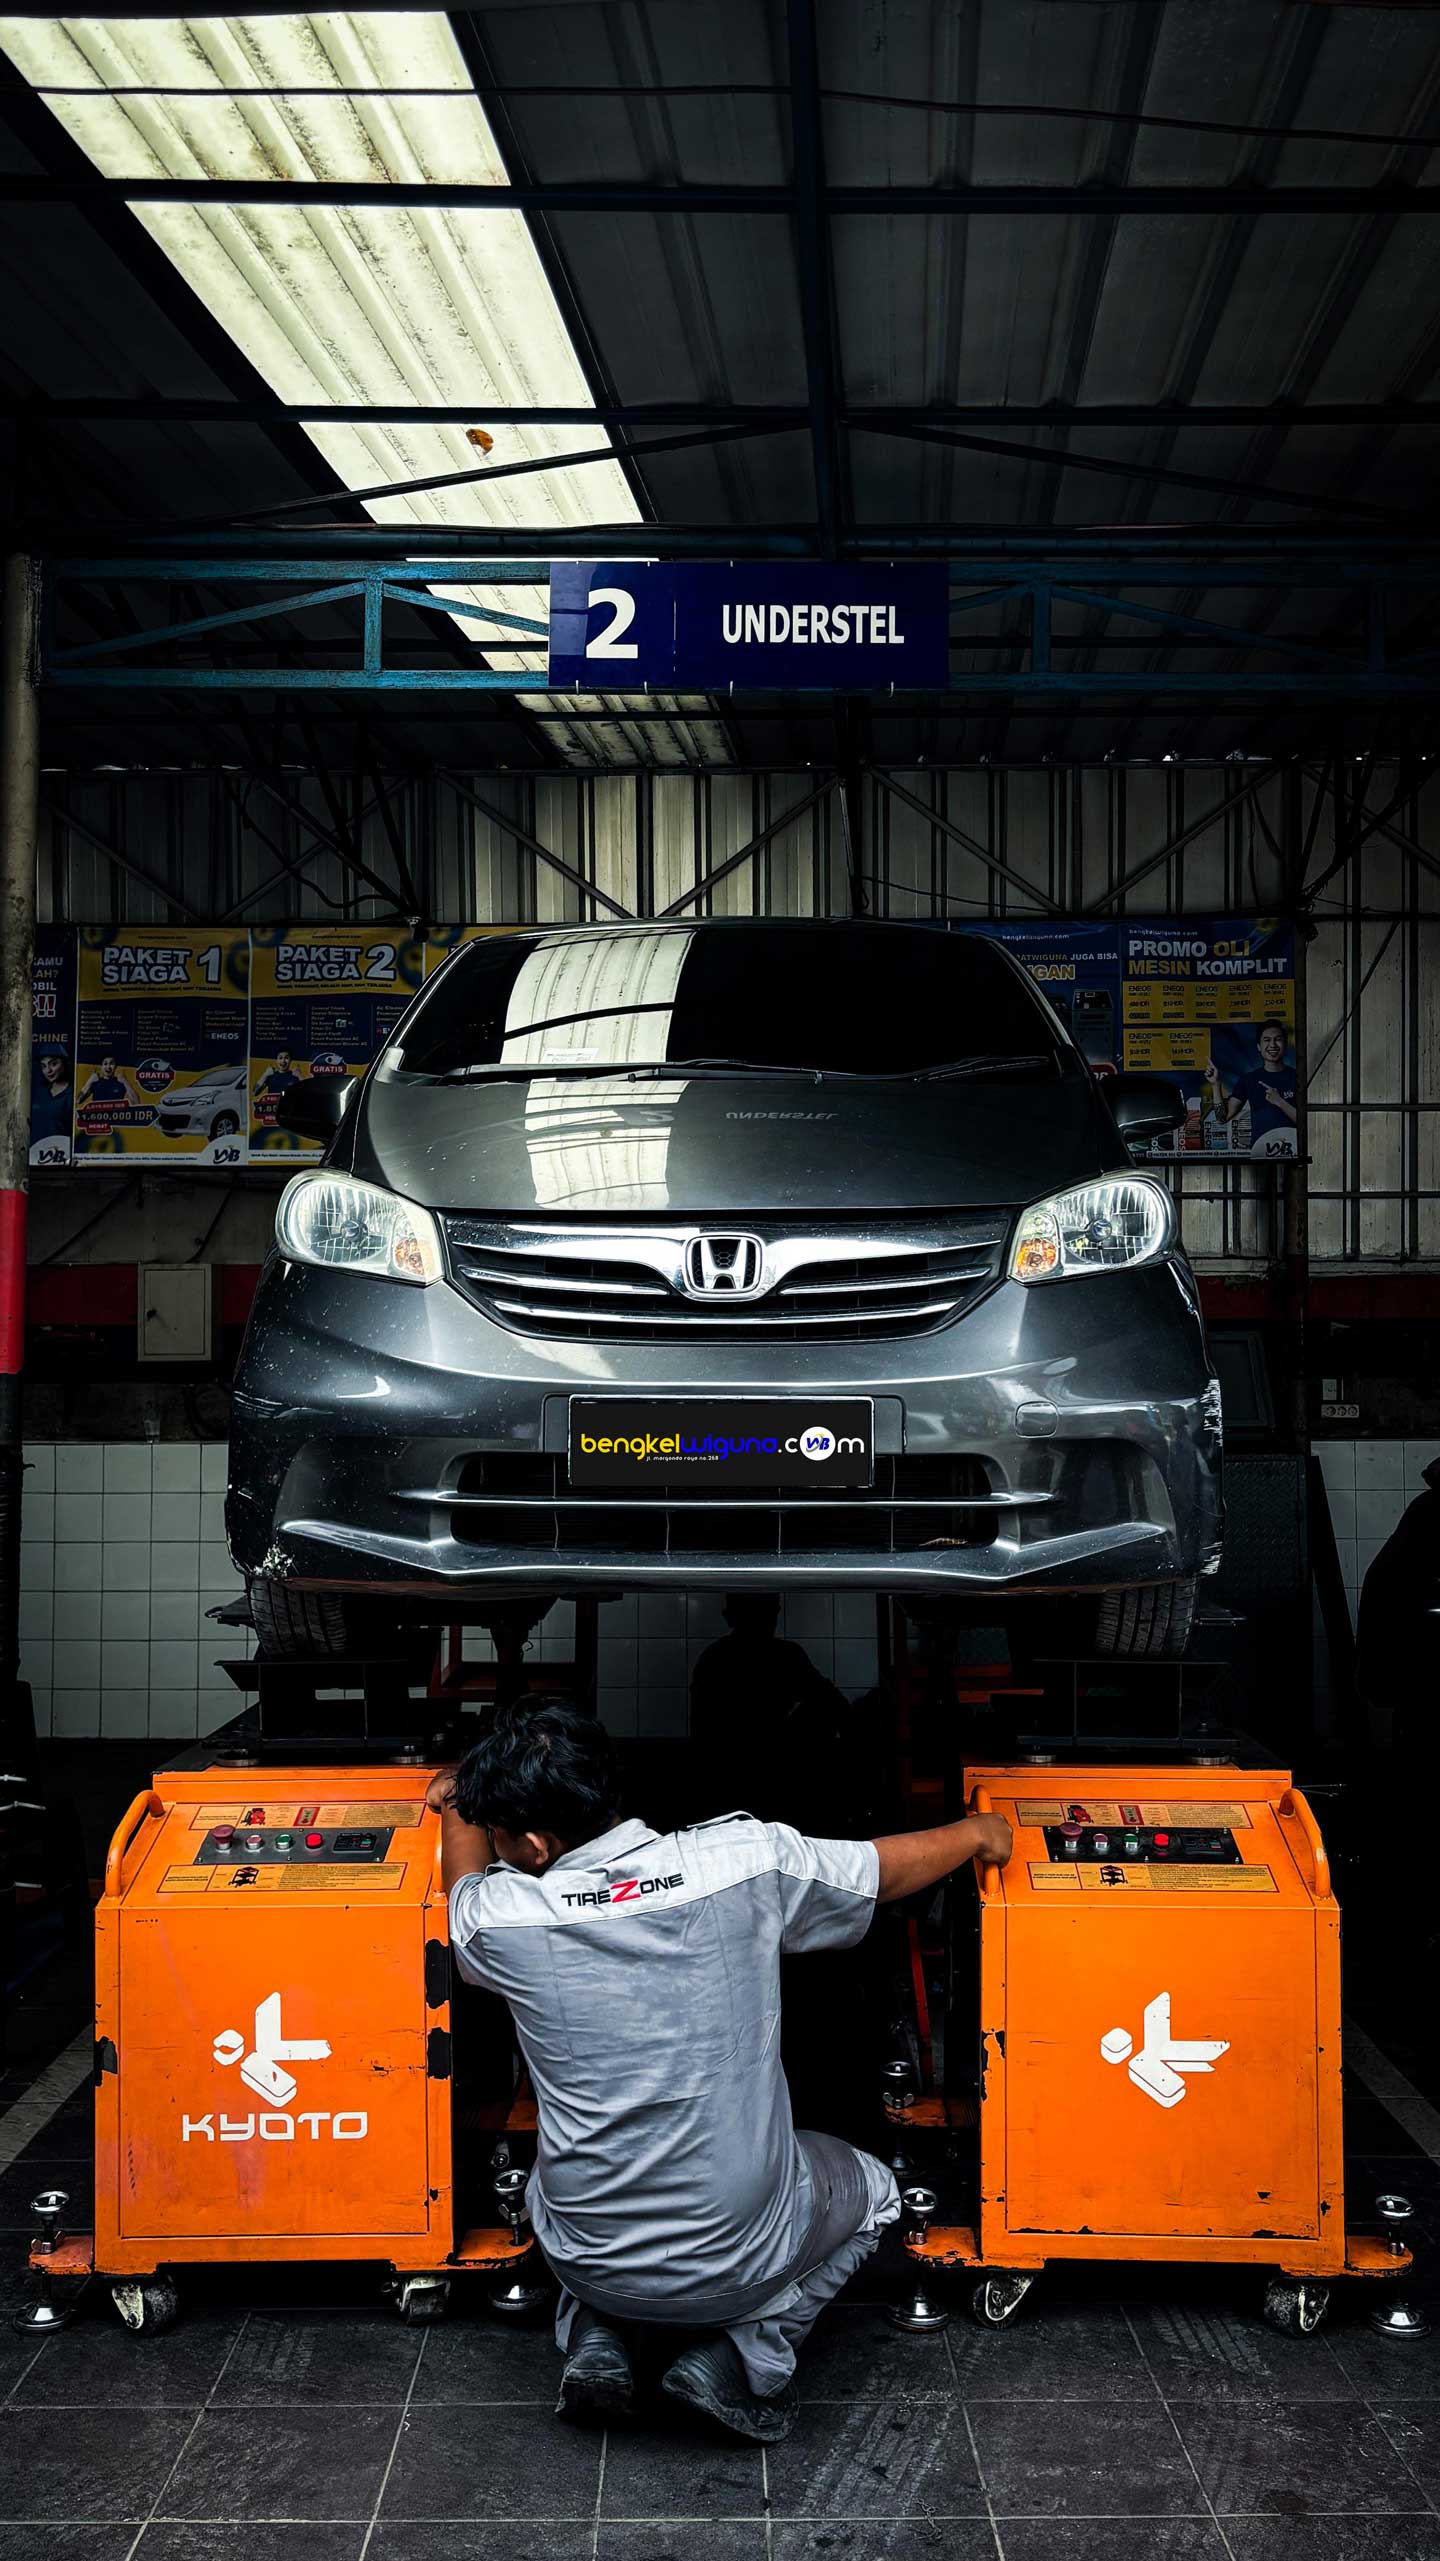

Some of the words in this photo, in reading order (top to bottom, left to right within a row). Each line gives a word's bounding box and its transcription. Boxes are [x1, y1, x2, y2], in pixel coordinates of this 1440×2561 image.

[586, 587, 639, 660] 2
[722, 604, 905, 645] UNDERSTEL
[103, 946, 192, 965] PAKET
[278, 945, 362, 962] PAKET
[1070, 953, 1095, 961] JUGA
[1097, 952, 1119, 960] BISA
[1128, 940, 1207, 958] PROMO
[1213, 940, 1250, 958] OLI
[198, 945, 222, 983] 1
[366, 944, 396, 980] 2
[1128, 959, 1191, 976] MESIN
[1196, 957, 1288, 976] KOMPLIT
[103, 965, 190, 984] SIAGA
[277, 963, 361, 981] SIAGA
[210, 1032, 240, 1040] ENEOS
[138, 1071, 171, 1079] GRATIS
[312, 1065, 344, 1073] GRATIS
[134, 1110, 153, 1121] IDR
[561, 1873, 685, 1907] TIREZONE
[182, 2111, 368, 2142] KYOTO
